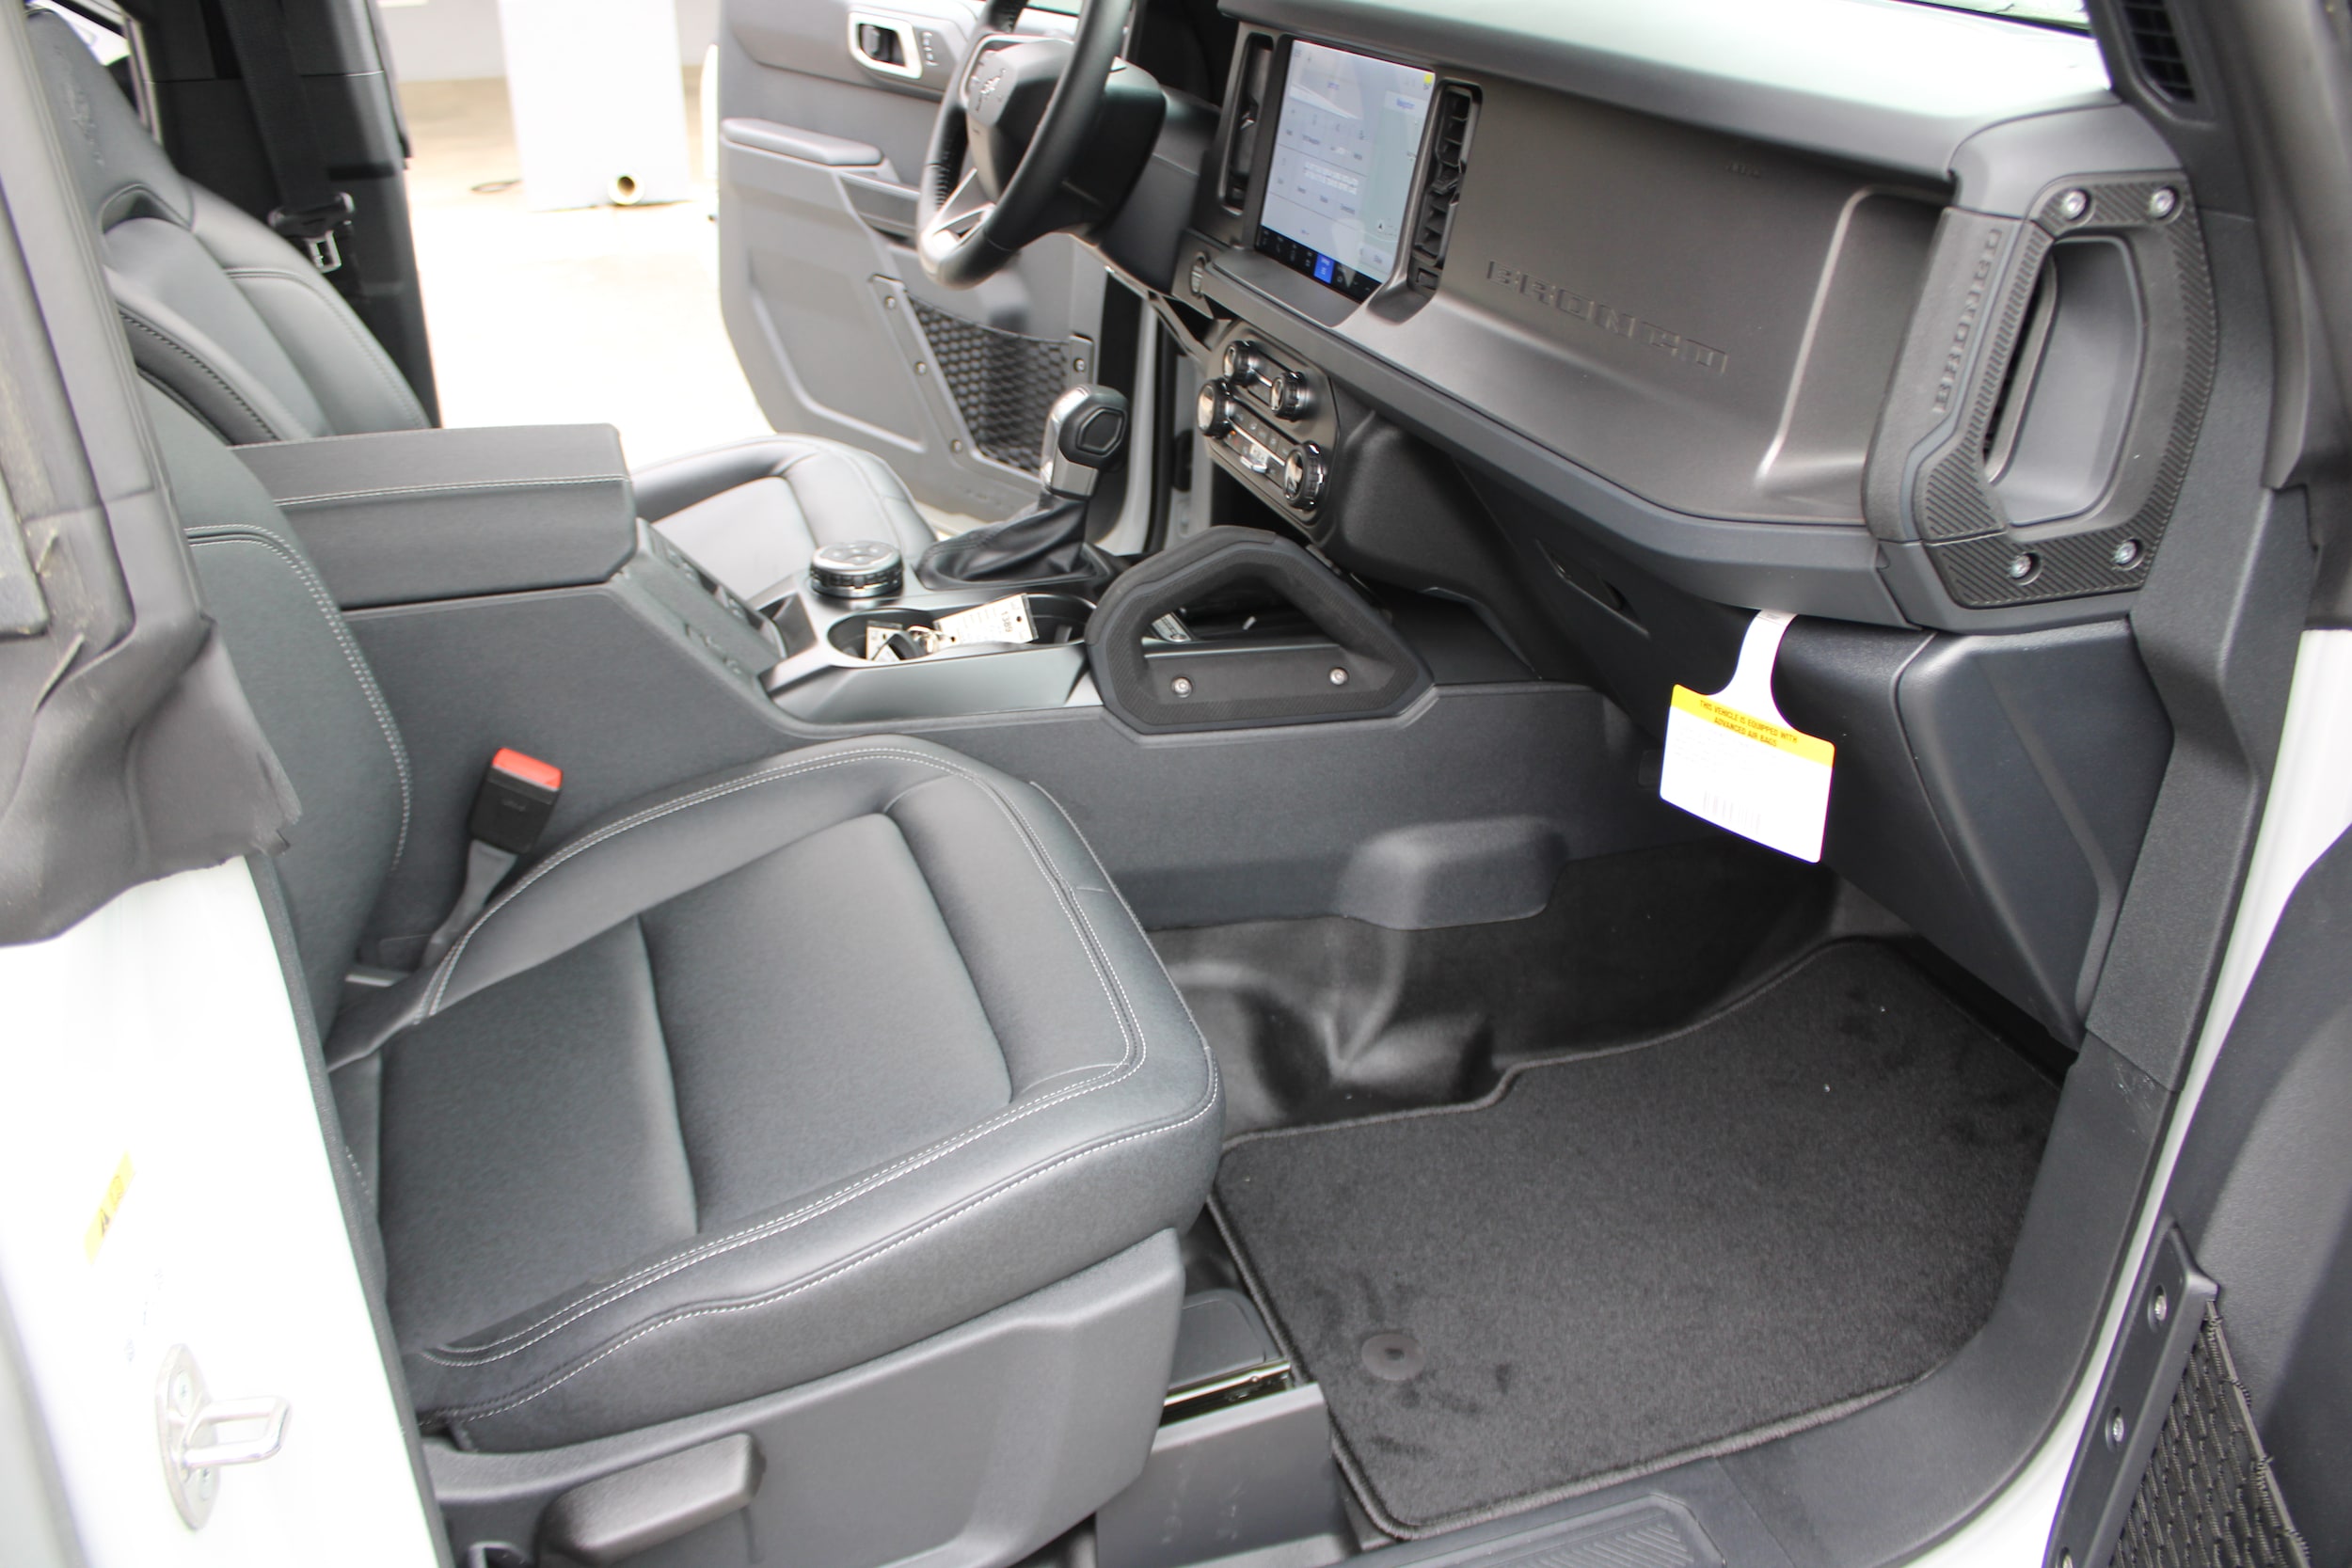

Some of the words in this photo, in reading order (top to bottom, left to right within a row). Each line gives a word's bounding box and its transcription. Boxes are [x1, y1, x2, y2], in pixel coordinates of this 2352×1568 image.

[1932, 228, 2003, 412] BRONCO
[1700, 700, 1712, 711] THIS
[1714, 706, 1739, 721] VEHICLE
[1740, 716, 1746, 724] IS
[1747, 719, 1779, 736] EQUIPPED
[1780, 731, 1798, 744] WITH
[1714, 717, 1746, 736] ADVANCED
[1747, 730, 1758, 739] AIR
[1760, 735, 1777, 747] BAGS
